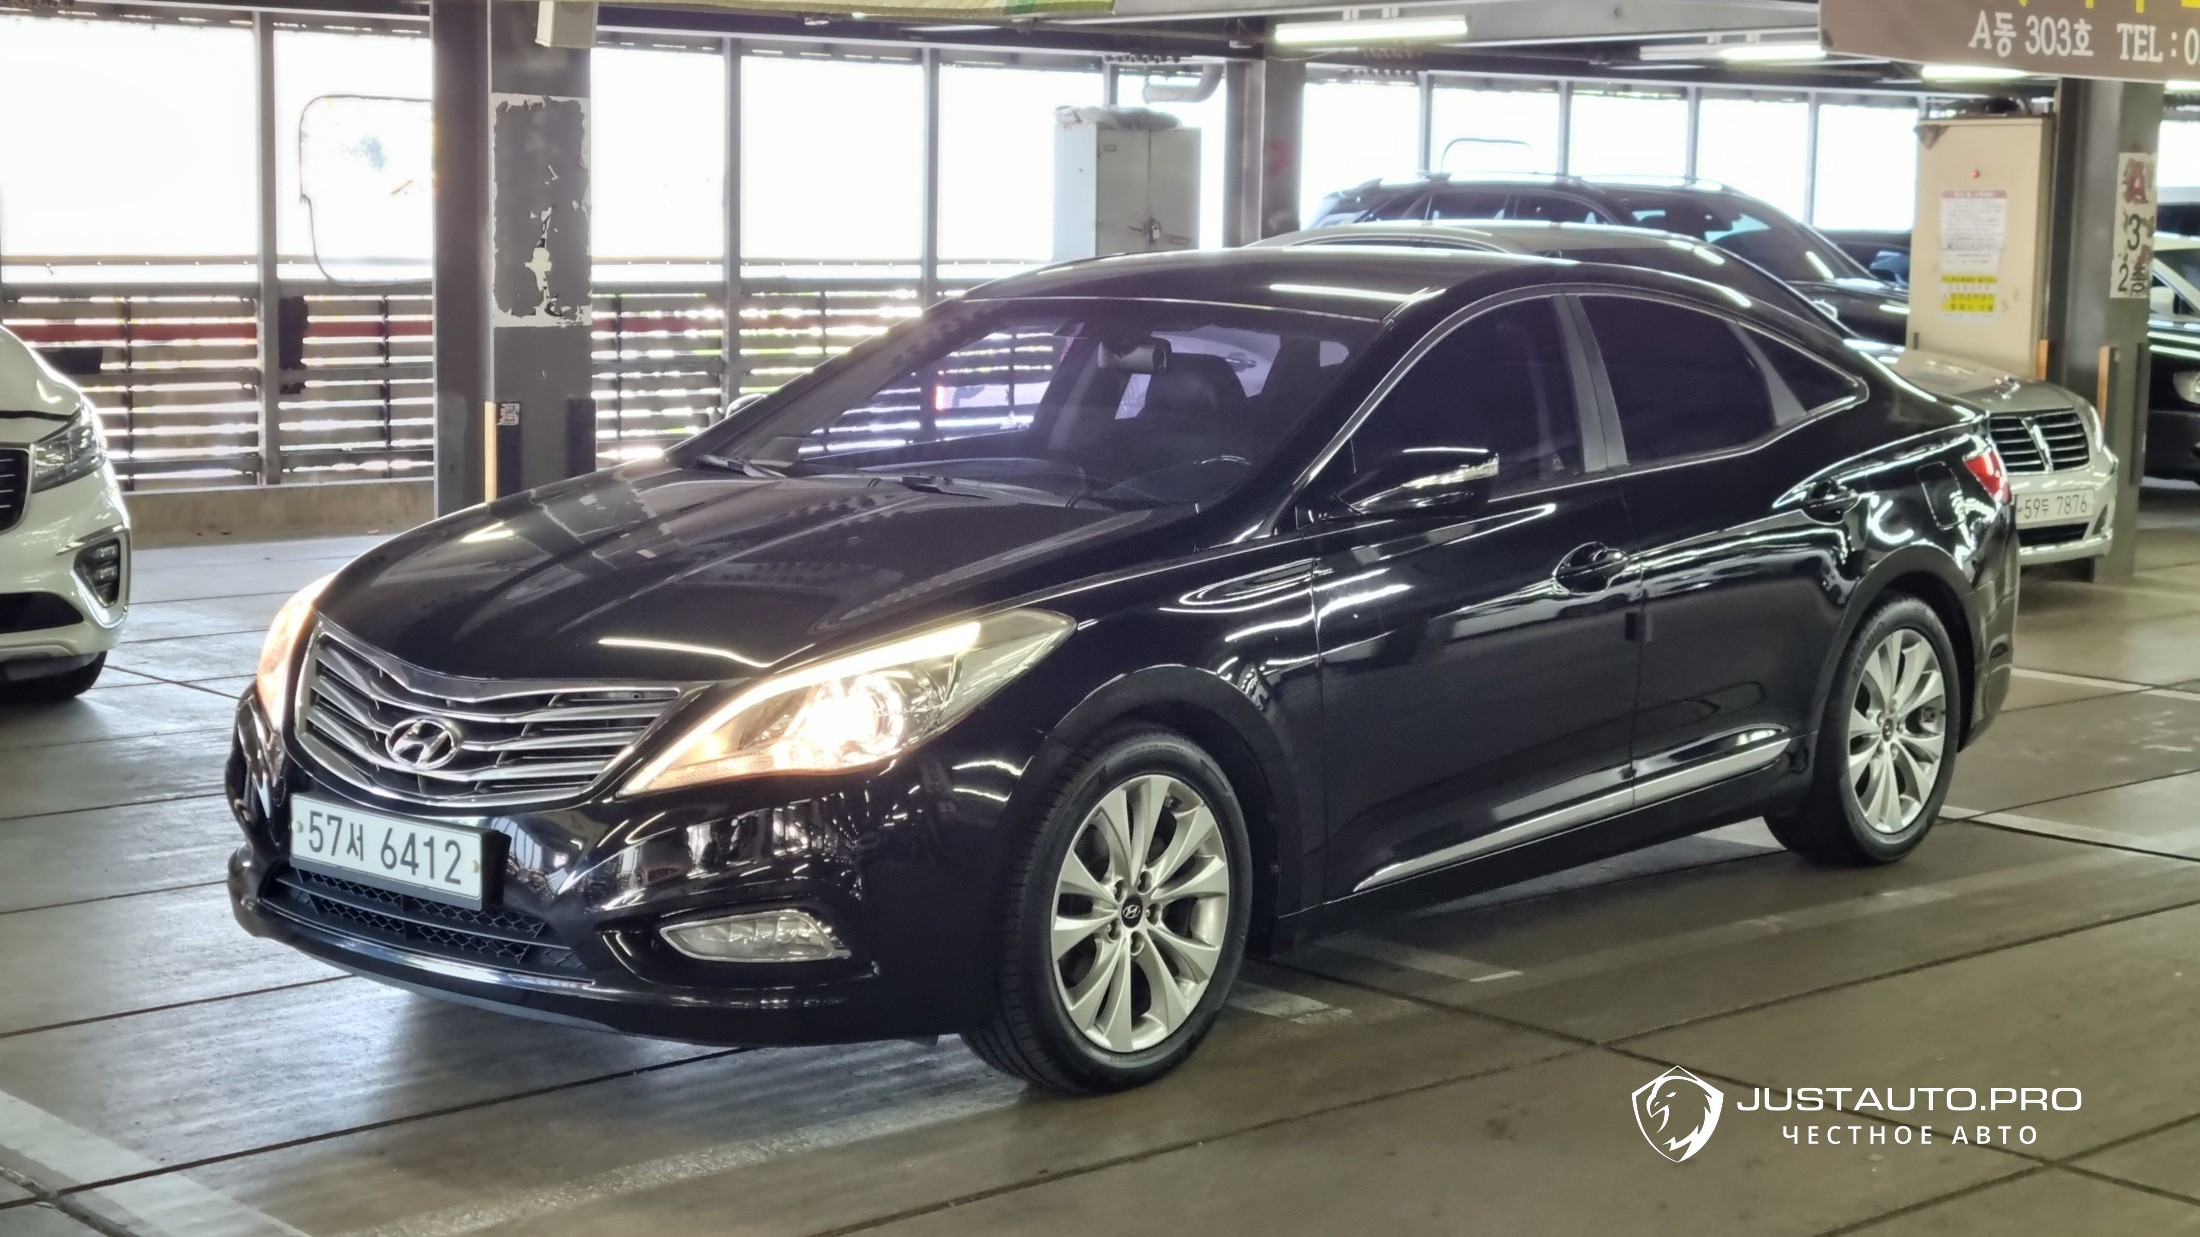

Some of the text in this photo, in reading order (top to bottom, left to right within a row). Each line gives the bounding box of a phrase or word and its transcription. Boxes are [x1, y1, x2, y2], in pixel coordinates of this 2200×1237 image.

[1968, 10, 2017, 57] A동
[2025, 15, 2094, 57] 303호
[2057, 494, 2088, 515] 7876
[308, 810, 461, 885] 57서 6412
